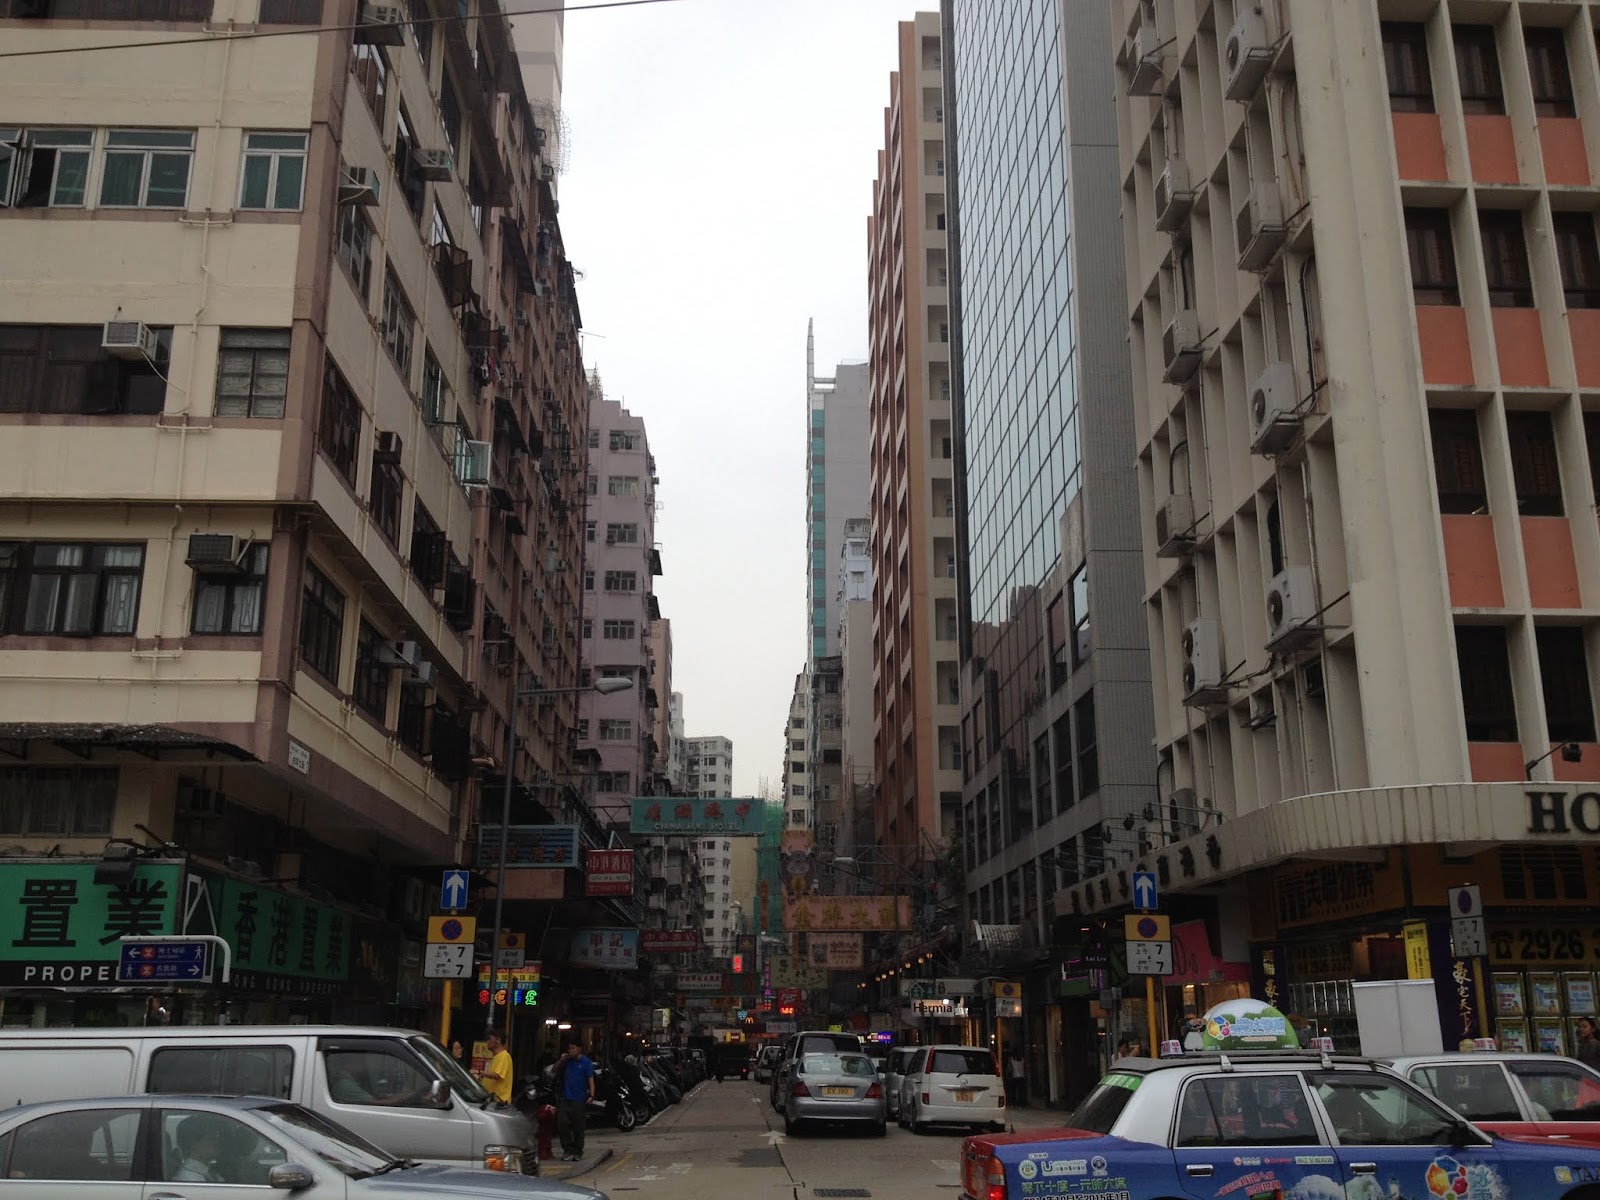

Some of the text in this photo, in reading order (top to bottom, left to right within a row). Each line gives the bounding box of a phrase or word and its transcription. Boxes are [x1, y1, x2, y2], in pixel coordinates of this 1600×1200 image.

[1525, 792, 1600, 834] HO
[12, 878, 167, 947] 置業
[235, 890, 343, 975] 香港置業
[1471, 920, 1477, 932] 7
[1155, 944, 1163, 955] 7
[1473, 940, 1480, 953] 7
[1520, 929, 1584, 960] 2926
[457, 946, 465, 958] 7
[24, 965, 120, 981] PROPE
[456, 964, 464, 976] 7
[1156, 961, 1164, 972] 7
[228, 974, 256, 989] ONG
[265, 976, 291, 992] KONG
[913, 1002, 953, 1013] Hermia
